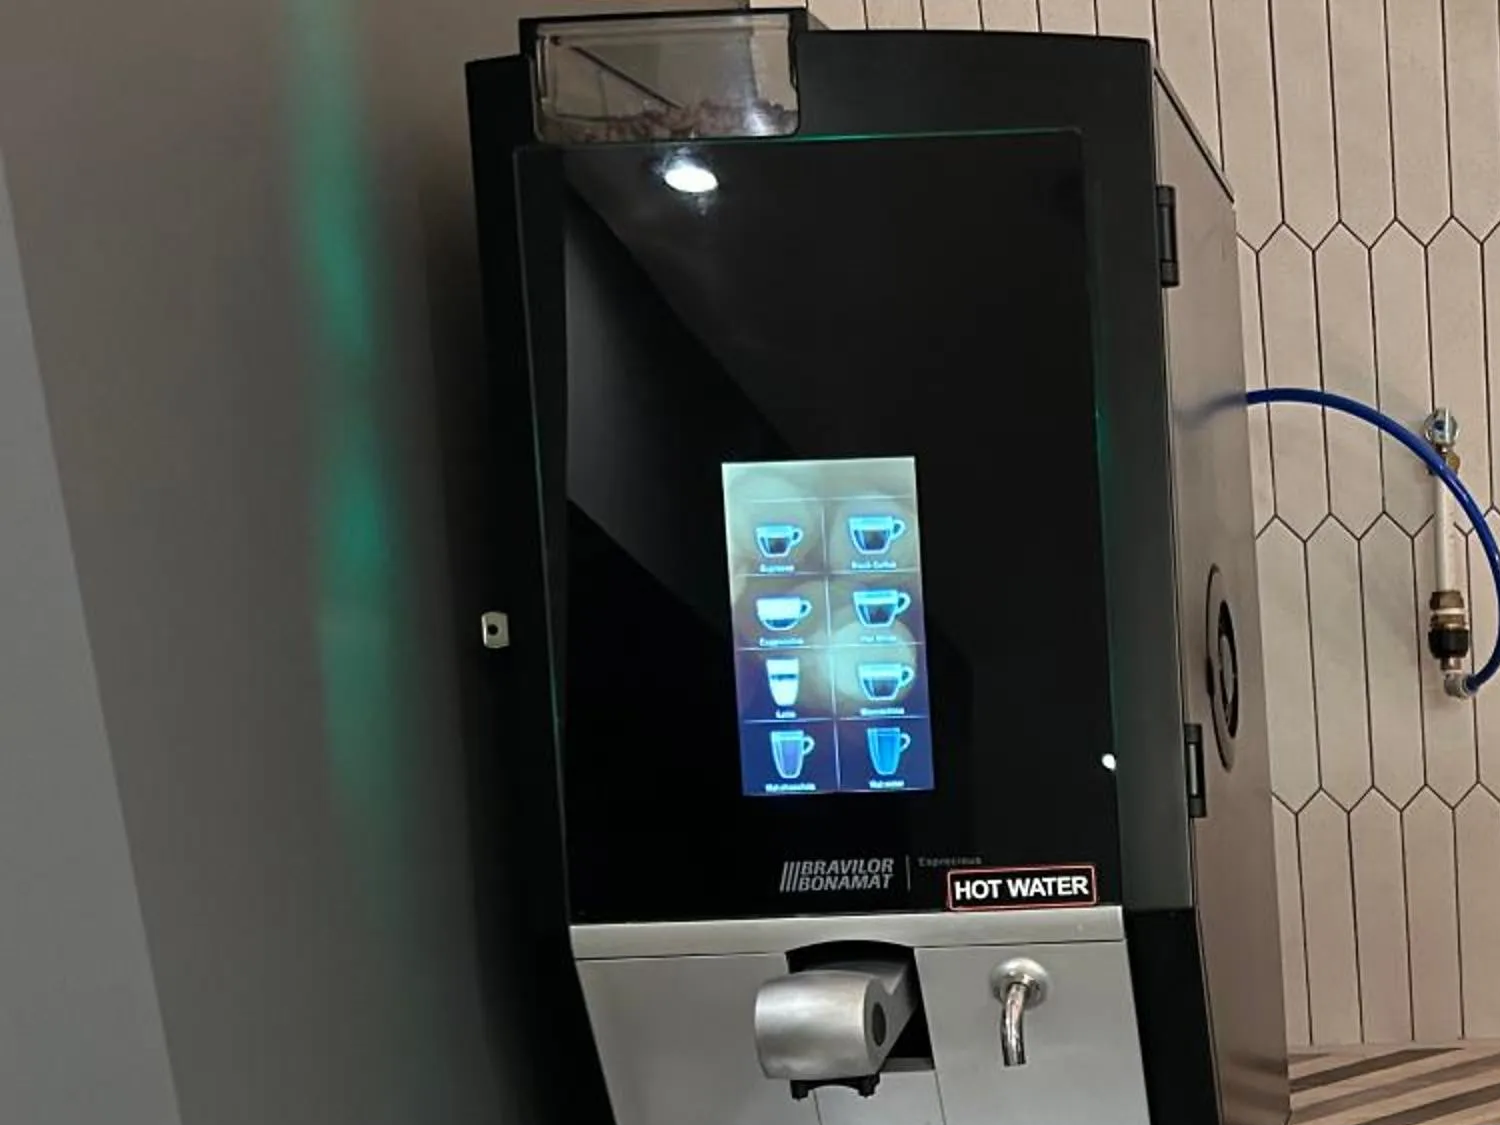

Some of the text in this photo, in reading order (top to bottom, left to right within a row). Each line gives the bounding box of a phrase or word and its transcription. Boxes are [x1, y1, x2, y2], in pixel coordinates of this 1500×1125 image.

[800, 858, 895, 876] BRAVILOR
[798, 873, 894, 892] BONAMAT
[954, 876, 1089, 900] HOT WATER
